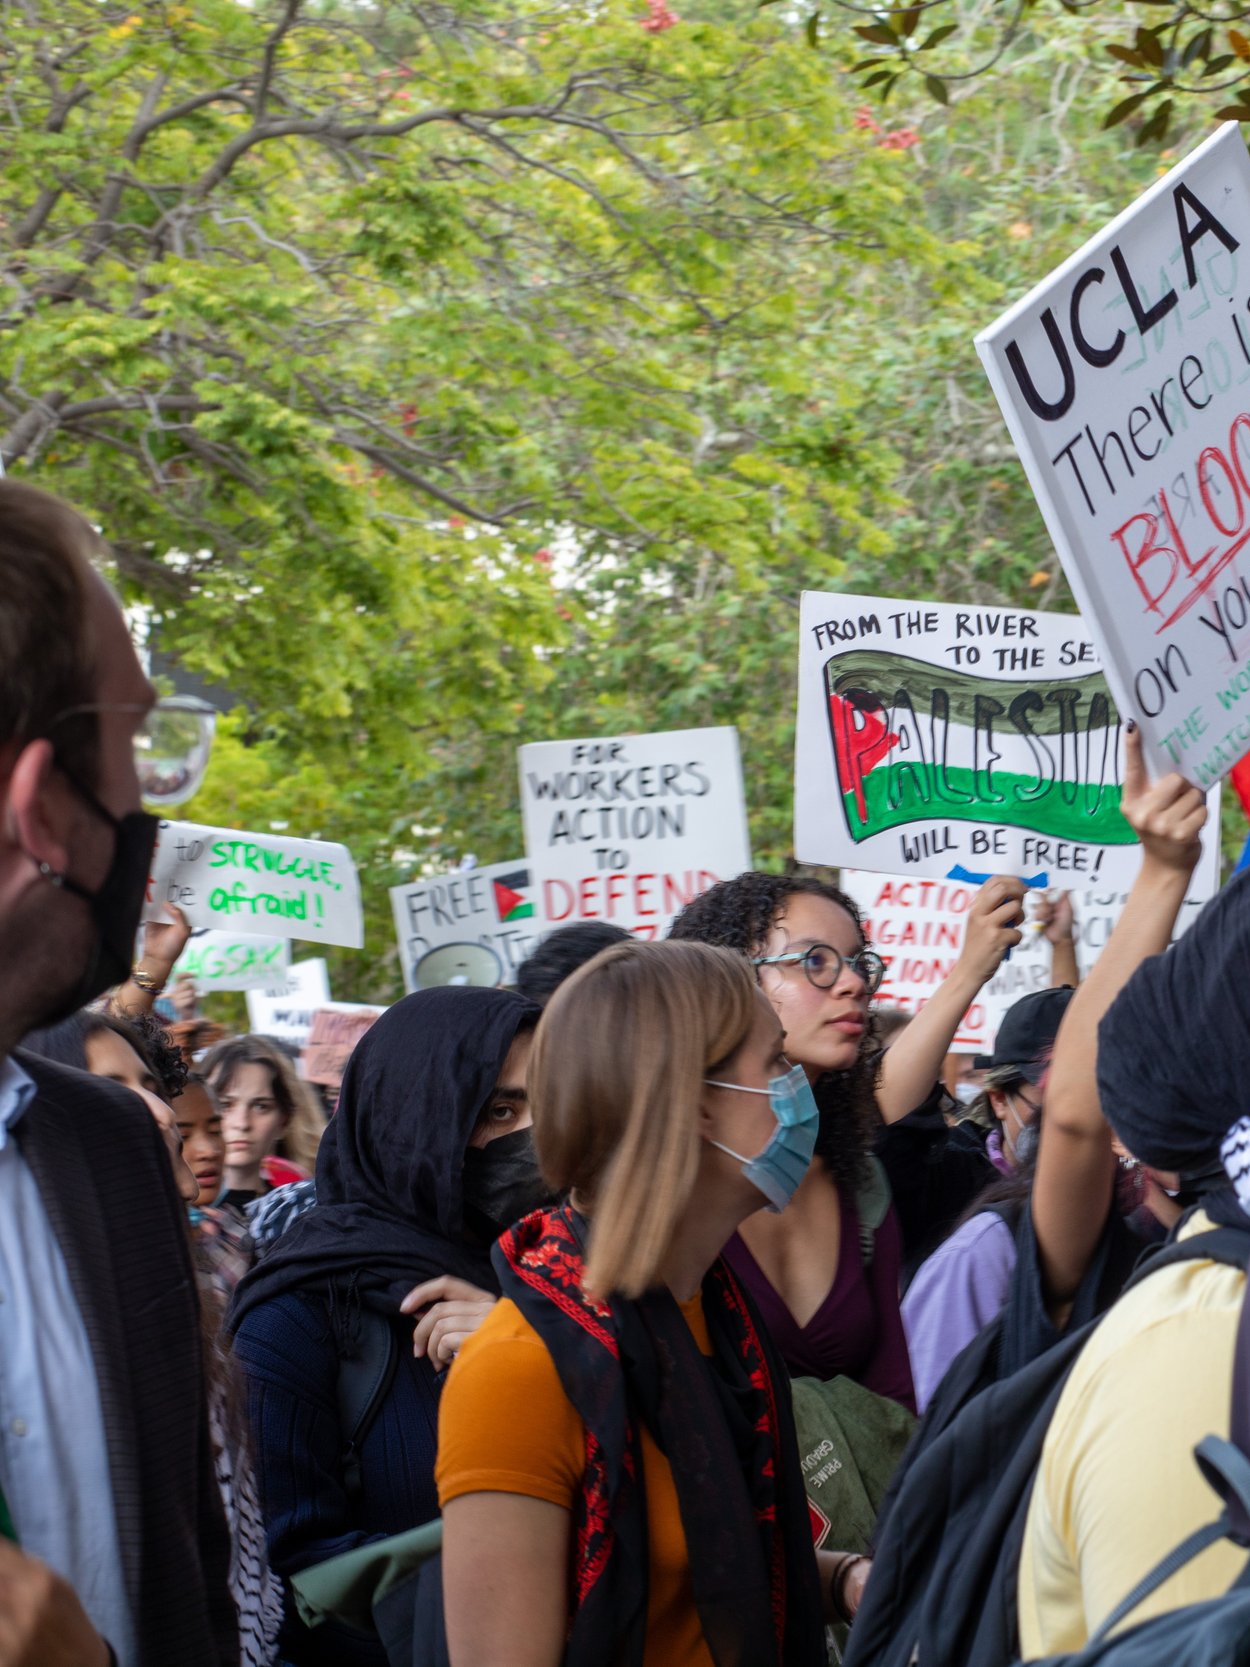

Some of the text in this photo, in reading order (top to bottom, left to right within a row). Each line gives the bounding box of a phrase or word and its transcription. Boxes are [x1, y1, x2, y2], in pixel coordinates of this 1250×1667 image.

[1004, 182, 1240, 421] UCLA
[1053, 354, 1214, 517] There
[811, 610, 1040, 650] FROM THE RIVER
[945, 640, 1101, 671] TO THE SE
[1134, 643, 1193, 718] on
[571, 742, 629, 765] FOR
[1158, 706, 1210, 765] THE
[527, 761, 711, 802] WORKERS
[548, 804, 686, 847] ACTION
[592, 848, 630, 870] TO
[900, 826, 1107, 882] WILL BE FREE!
[209, 881, 324, 928] afraid!
[406, 876, 487, 933] FREE
[874, 881, 978, 913] ACTIO
[800, 1439, 835, 1476] GRADU
